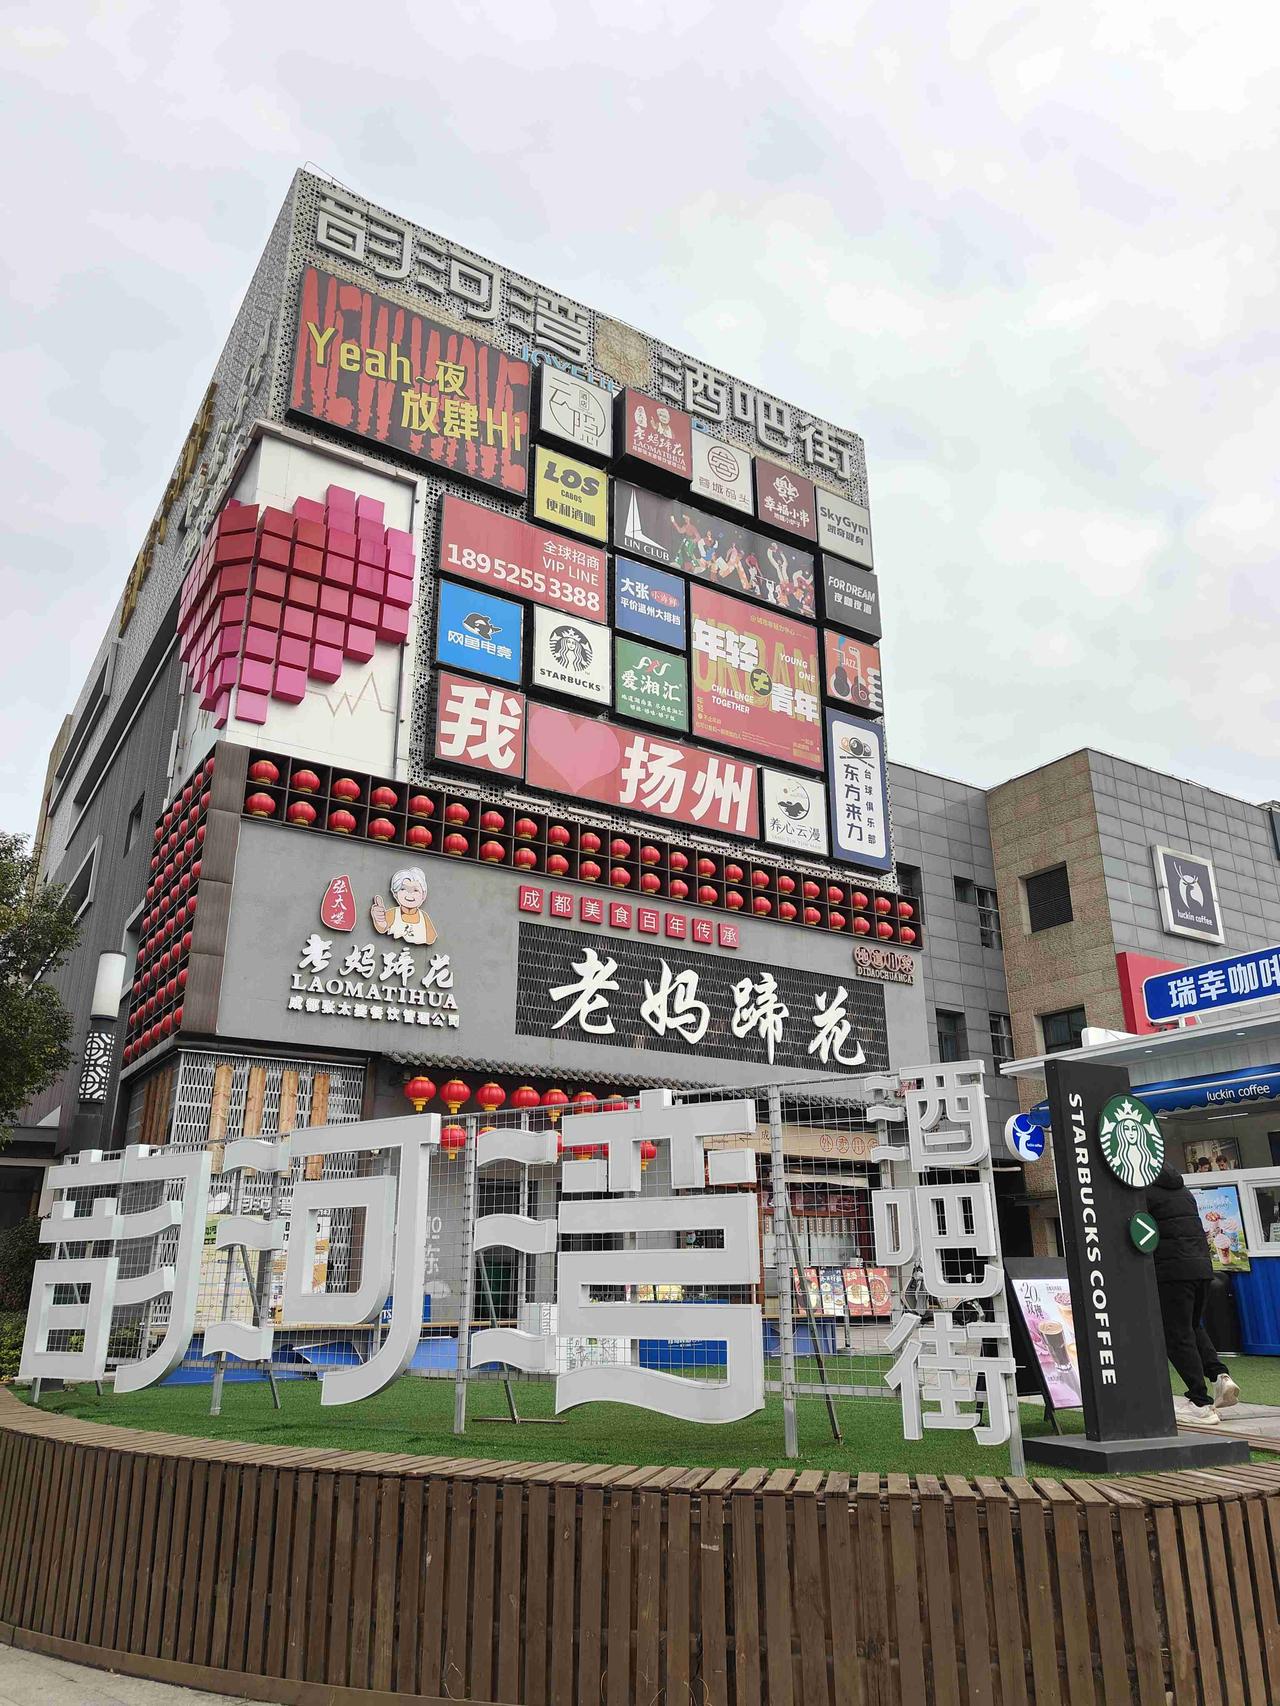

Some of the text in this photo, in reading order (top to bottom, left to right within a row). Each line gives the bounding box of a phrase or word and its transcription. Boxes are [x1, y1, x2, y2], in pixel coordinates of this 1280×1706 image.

[660, 350, 852, 482] 酒吧街
[543, 461, 600, 497] LOS
[561, 489, 583, 504] CABOS
[763, 496, 810, 528] 幸福小串
[820, 506, 868, 536] SkyGym
[543, 540, 600, 571] 全球招商
[624, 537, 670, 561] LIN CLUB
[543, 556, 599, 587] VIP LINE
[621, 578, 650, 600] 大张
[828, 575, 876, 603] FOR DREAM
[620, 597, 681, 626] 平价温州大排档
[447, 630, 512, 660] 网鱼电竞
[693, 619, 758, 673] 年轻
[780, 652, 808, 669] YOUNG
[539, 668, 601, 692] STARBUCKS
[621, 670, 681, 702] 爱湘汇
[799, 671, 816, 683] ONE
[711, 684, 754, 704] CHALLENGE
[711, 695, 750, 715] TOGETHER
[772, 682, 820, 722] 青年
[440, 685, 753, 834] 我 扬州
[843, 763, 863, 841] 东方来力
[864, 769, 876, 845] 台球俱乐部
[770, 816, 821, 842] 养心云漫
[521, 886, 738, 947] 成都美食百年传承
[1177, 909, 1213, 927] luckin coffee
[298, 933, 455, 989] 老妈蹄花
[855, 946, 915, 974] 地道川菜
[291, 972, 459, 1010] LAOMATIHUA
[1169, 952, 1280, 1010] 瑞幸咖啡
[288, 996, 460, 1029] 成都张太婆餐饮管理公司
[549, 947, 866, 1066] 老妈蹄花
[1207, 1084, 1270, 1102] luckin coffee
[864, 1060, 1014, 1446] 酒吧街
[1069, 1093, 1117, 1385] STARBUCKS COFFEE
